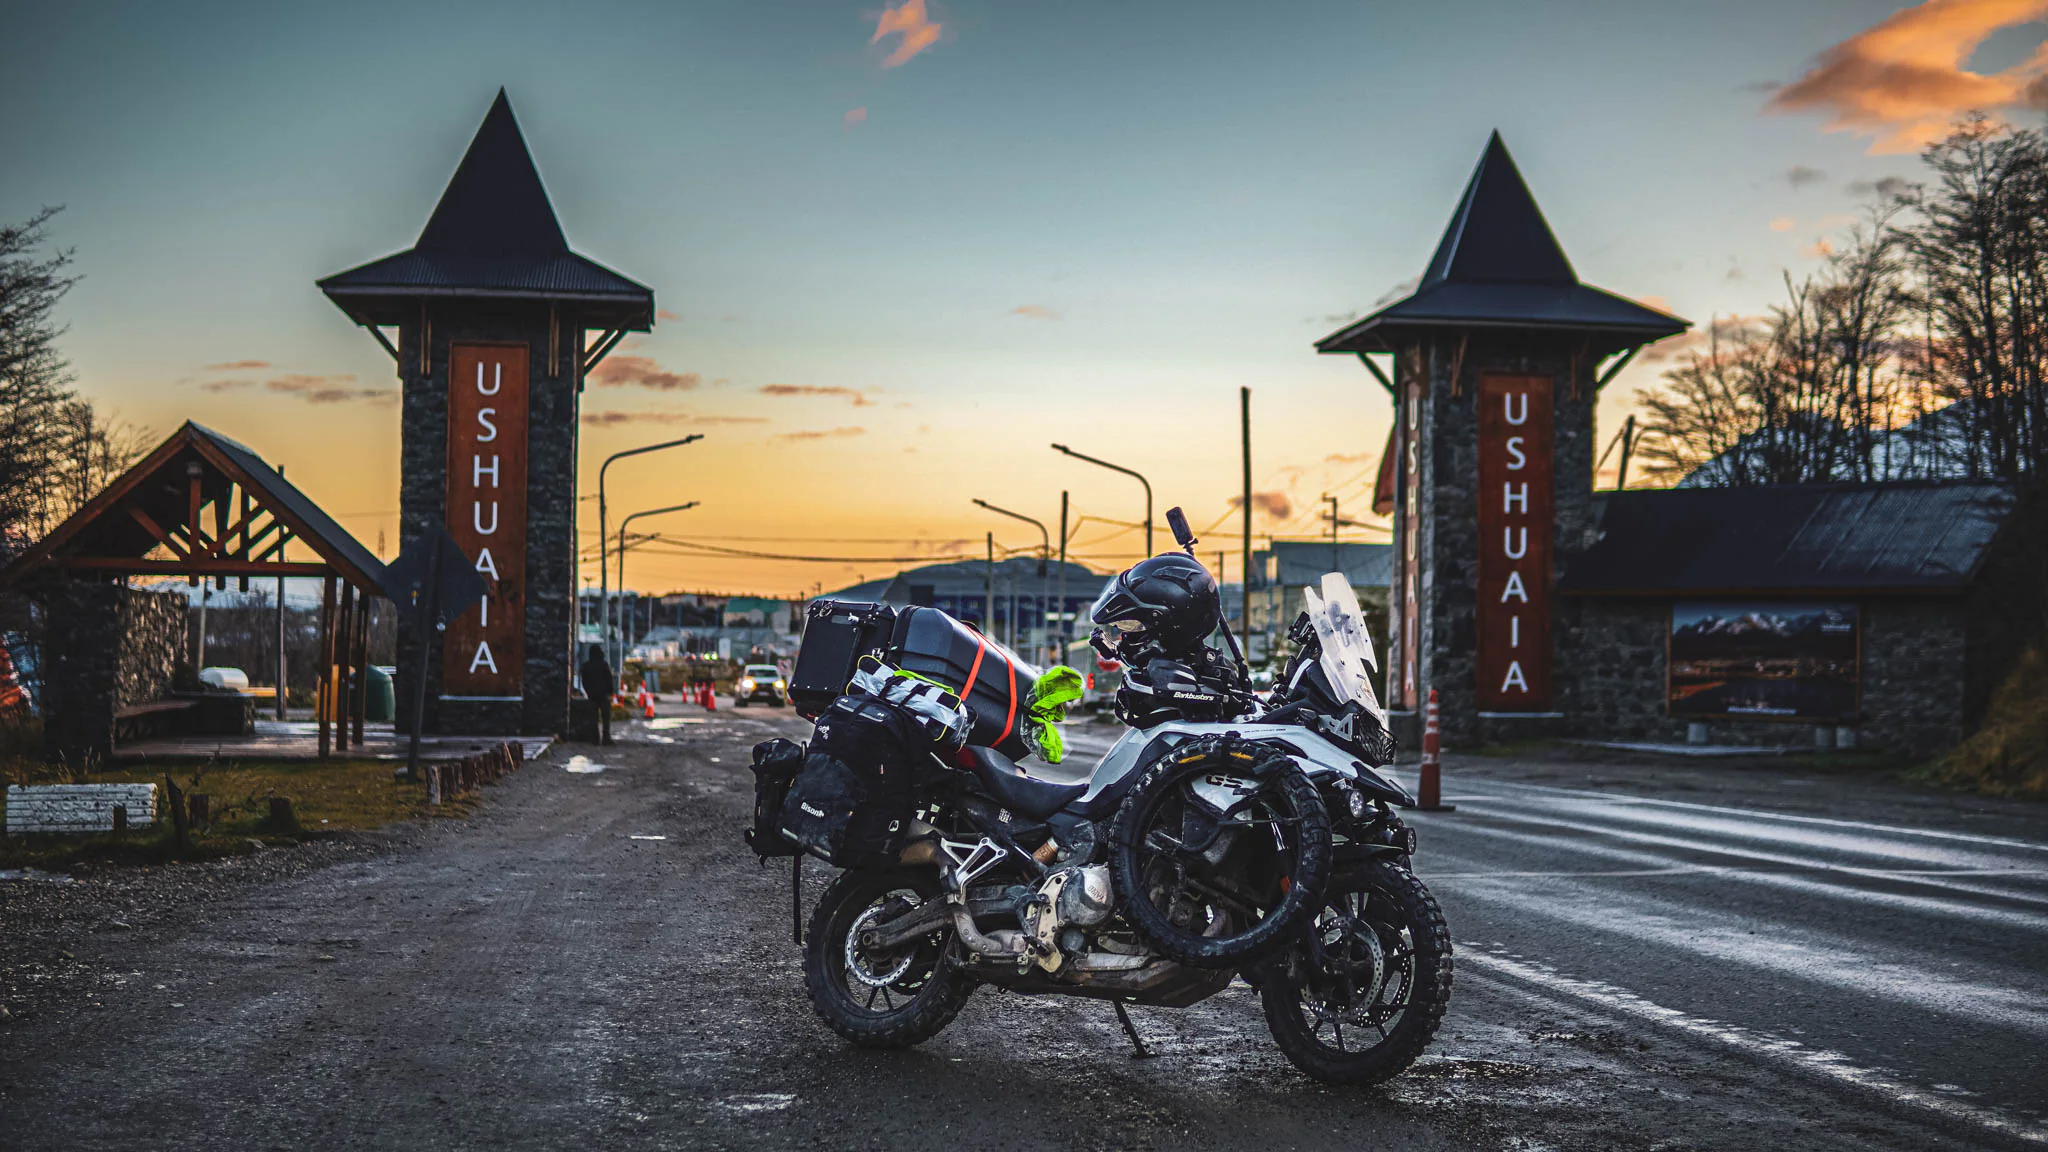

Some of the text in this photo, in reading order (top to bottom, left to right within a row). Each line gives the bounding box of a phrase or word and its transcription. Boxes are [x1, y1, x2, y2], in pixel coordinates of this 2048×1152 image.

[469, 361, 501, 674] USHUAIA
[1405, 398, 1418, 691] USHUAIA
[1500, 392, 1529, 693] USHUAIA
[1173, 691, 1215, 701] Barkbusters
[1205, 775, 1243, 788] GS
